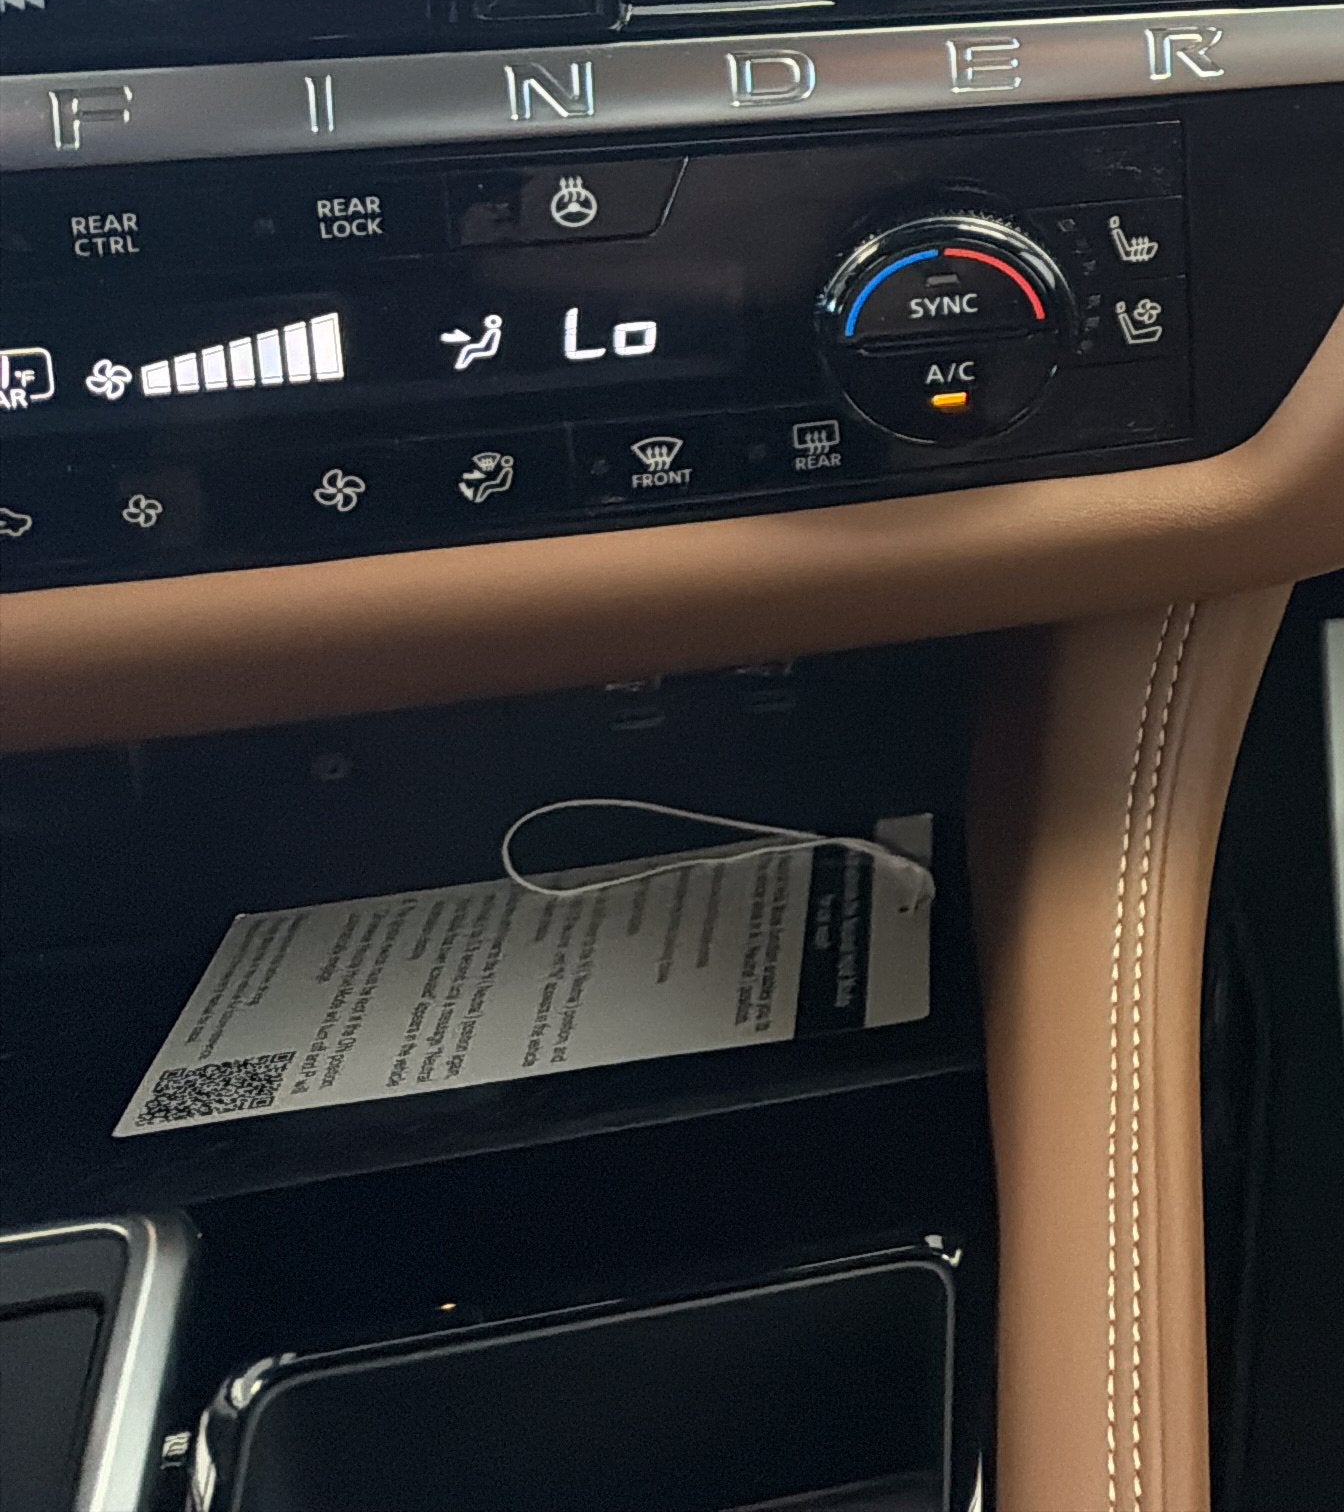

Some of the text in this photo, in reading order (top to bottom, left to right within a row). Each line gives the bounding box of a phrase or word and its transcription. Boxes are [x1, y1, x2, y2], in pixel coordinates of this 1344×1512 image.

[316, 195, 381, 219] REAR
[70, 212, 139, 236] REAR
[319, 217, 383, 240] LOCK
[73, 235, 140, 257] CTRL
[909, 293, 979, 319] SYNC
[564, 307, 657, 360] Lo
[925, 361, 976, 384] A/C
[795, 453, 842, 471] REAR
[631, 468, 692, 489] FRONT
